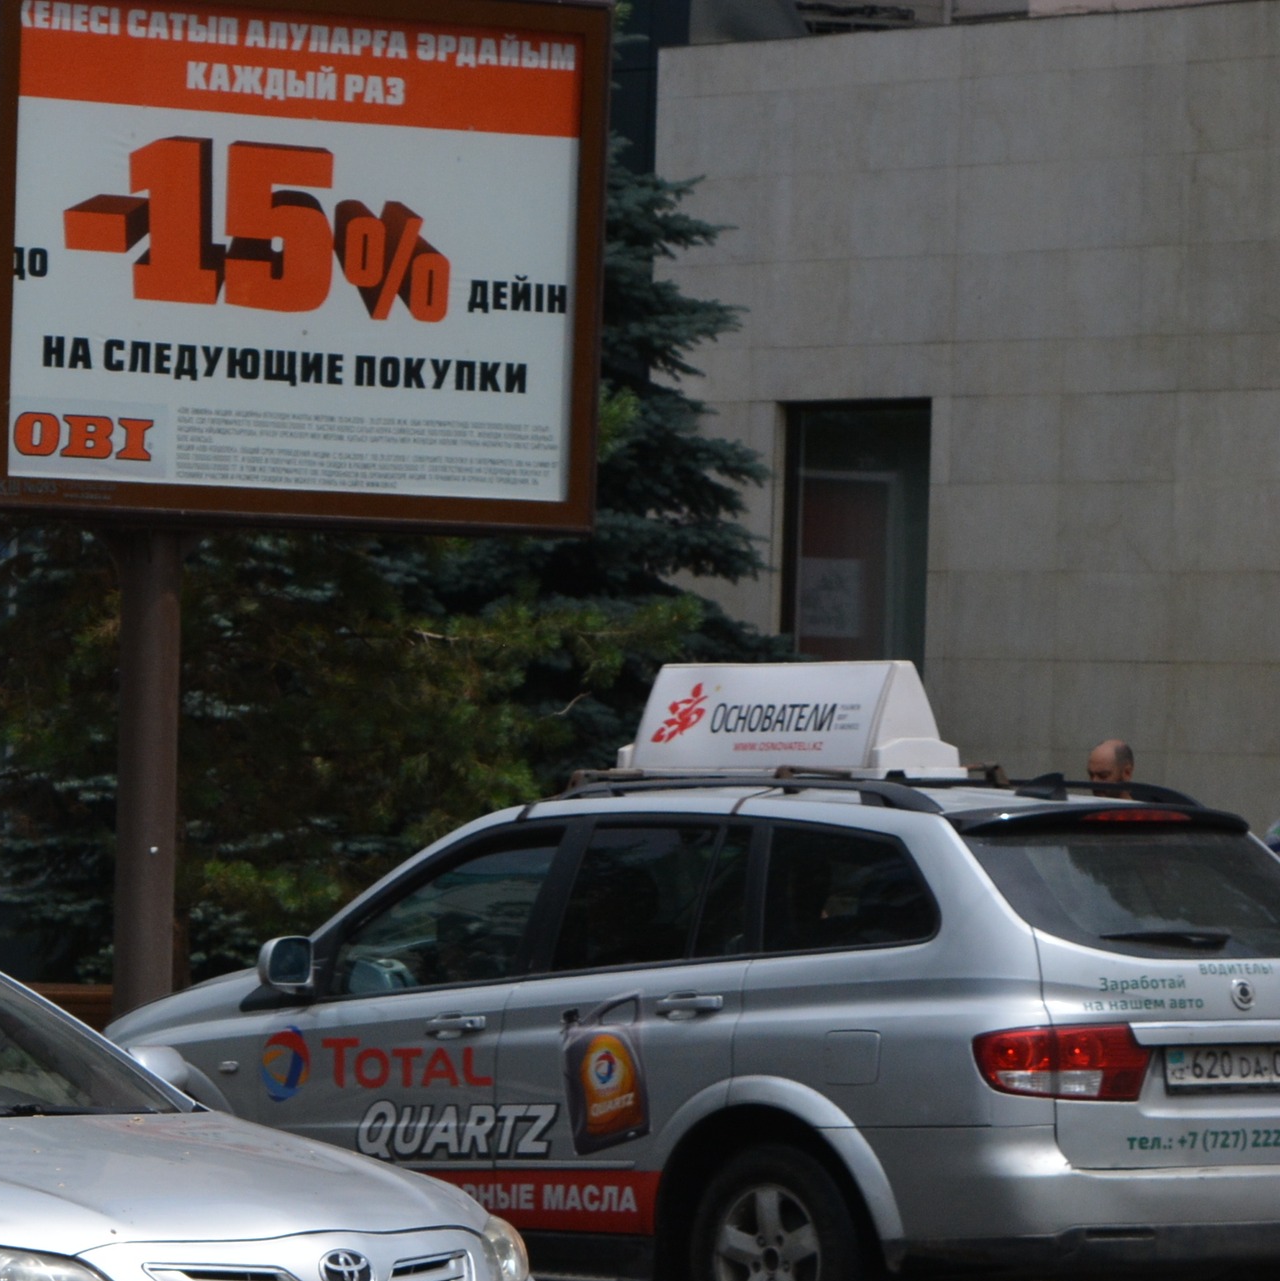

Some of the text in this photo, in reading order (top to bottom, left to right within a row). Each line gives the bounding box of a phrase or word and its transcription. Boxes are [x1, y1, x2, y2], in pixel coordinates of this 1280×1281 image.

[126, 8, 238, 46] САТЫП
[186, 60, 406, 105] КАЖДЫЙ РАЗ
[62, 135, 451, 323] -15%
[467, 273, 567, 314] ДЕЙІН
[42, 335, 528, 395] НА СЛЕДУЮЩИЕ ПОКУПКИ
[13, 410, 156, 462] OBI
[710, 702, 837, 734] ОСНОВАТЕЛИ
[1099, 975, 1186, 993] Заработай
[1083, 998, 1204, 1012] на нашем авто
[1192, 1051, 1233, 1079] 620
[359, 1101, 558, 1160] QUARTZ
[1127, 1136, 1173, 1151] тел.:
[1178, 1131, 1199, 1149] +7
[1202, 1128, 1247, 1152] (727)
[543, 1184, 637, 1213] МАСЛА
